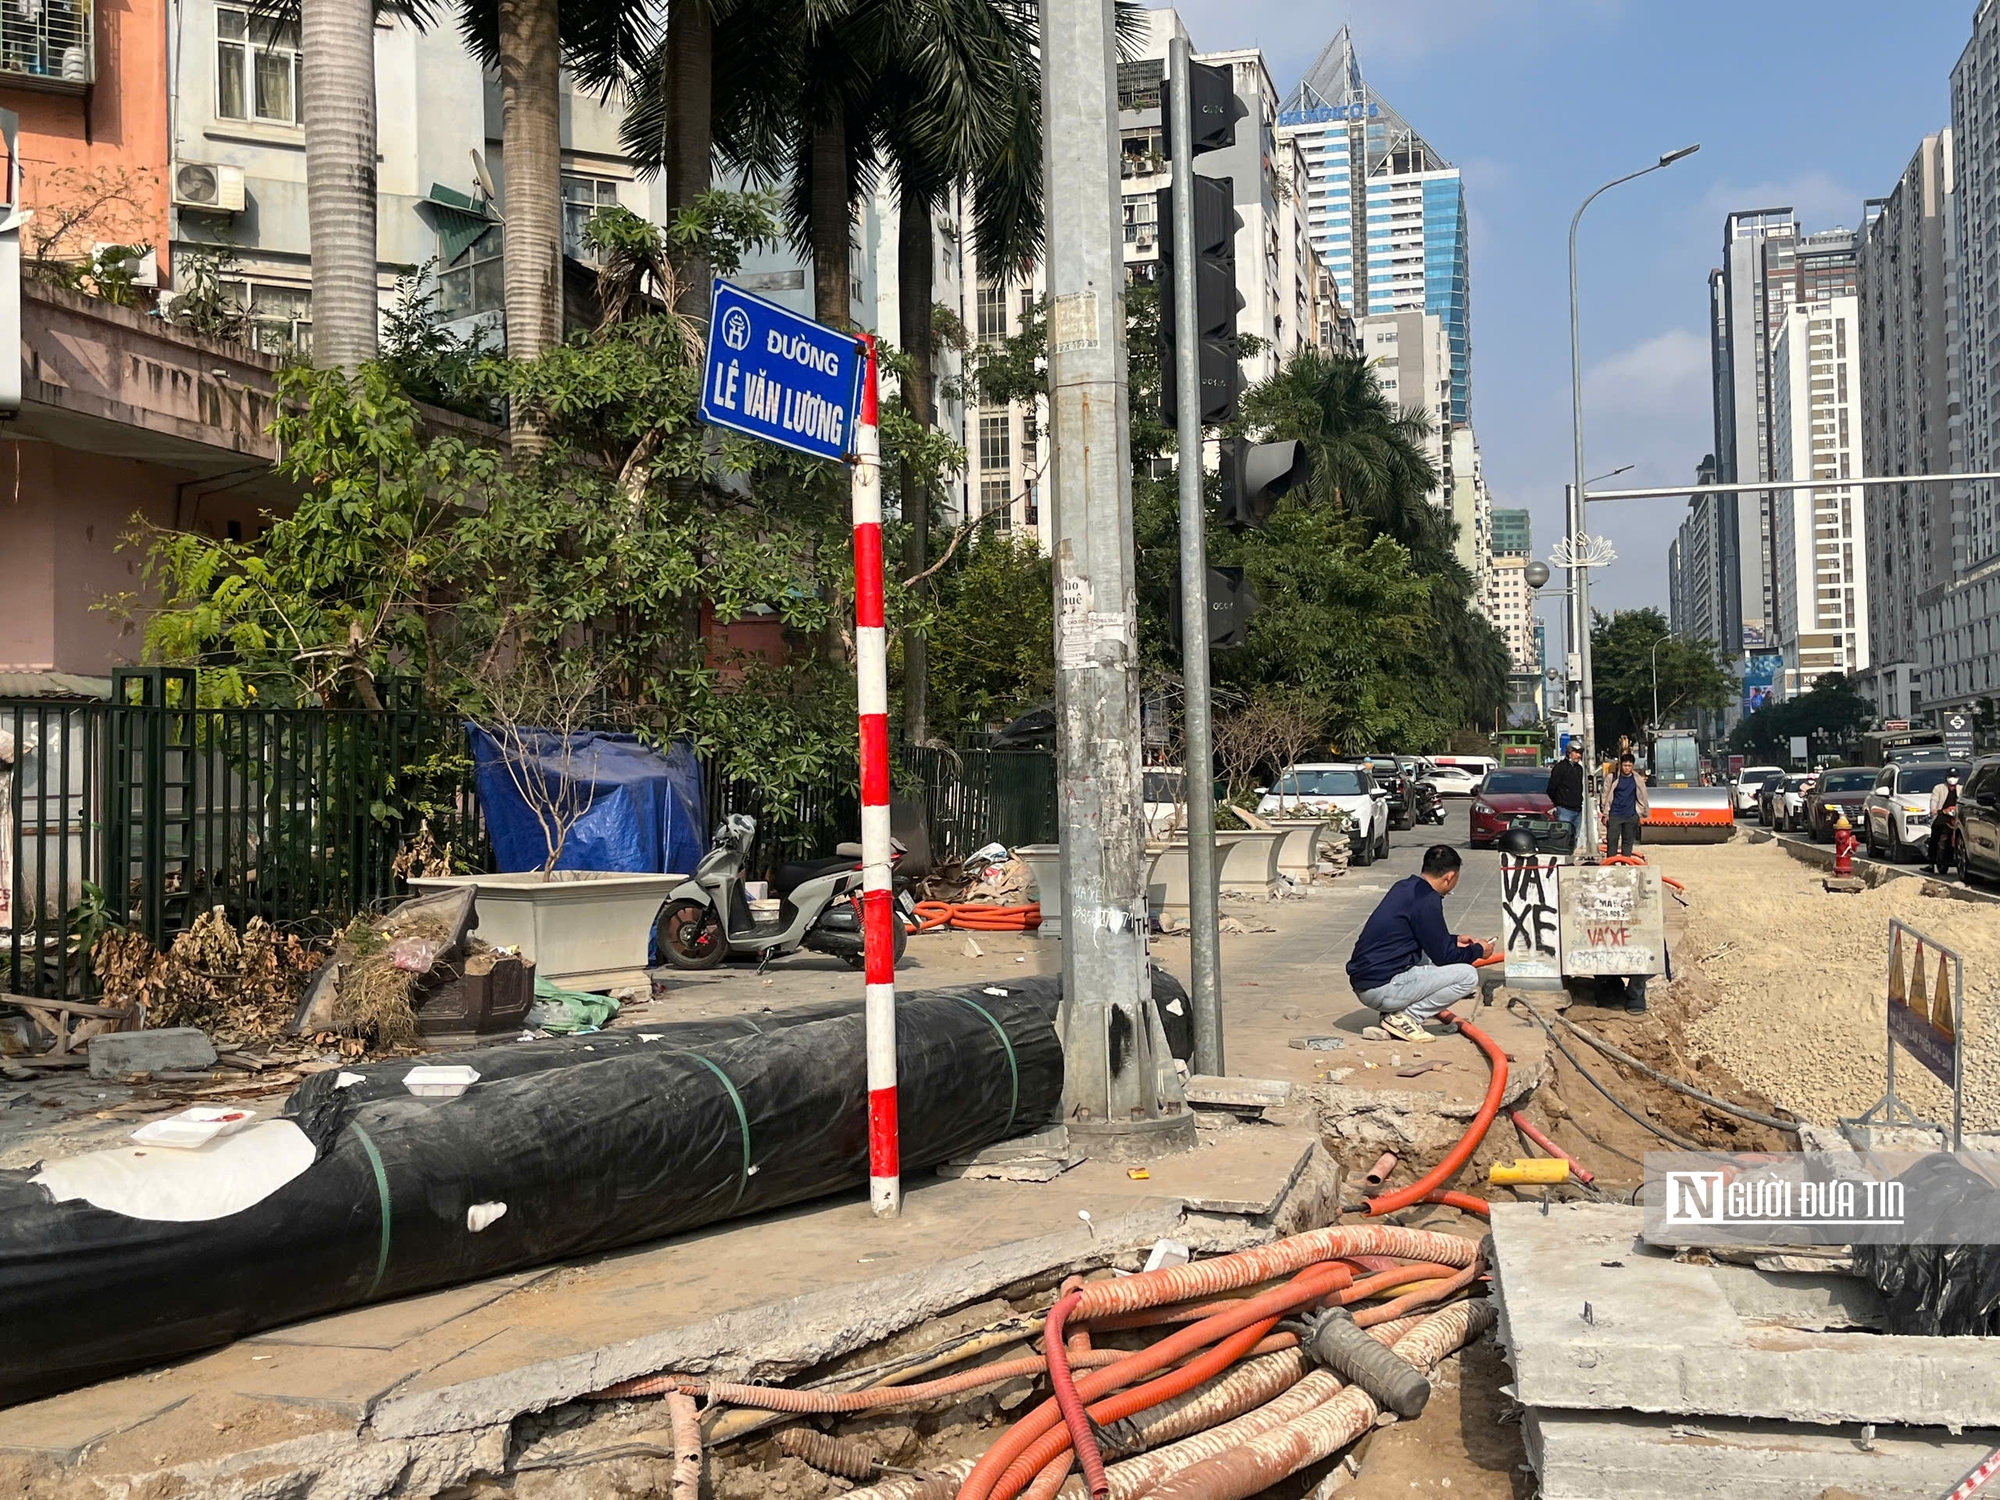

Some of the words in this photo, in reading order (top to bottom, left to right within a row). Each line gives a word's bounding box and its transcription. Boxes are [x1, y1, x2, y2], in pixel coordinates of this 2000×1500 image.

[767, 329, 839, 377] ĐƯỜNG
[713, 358, 740, 411] LÊ
[743, 367, 781, 425] VĂN
[782, 387, 844, 447] LƯƠNG
[1503, 901, 1557, 958] XE
